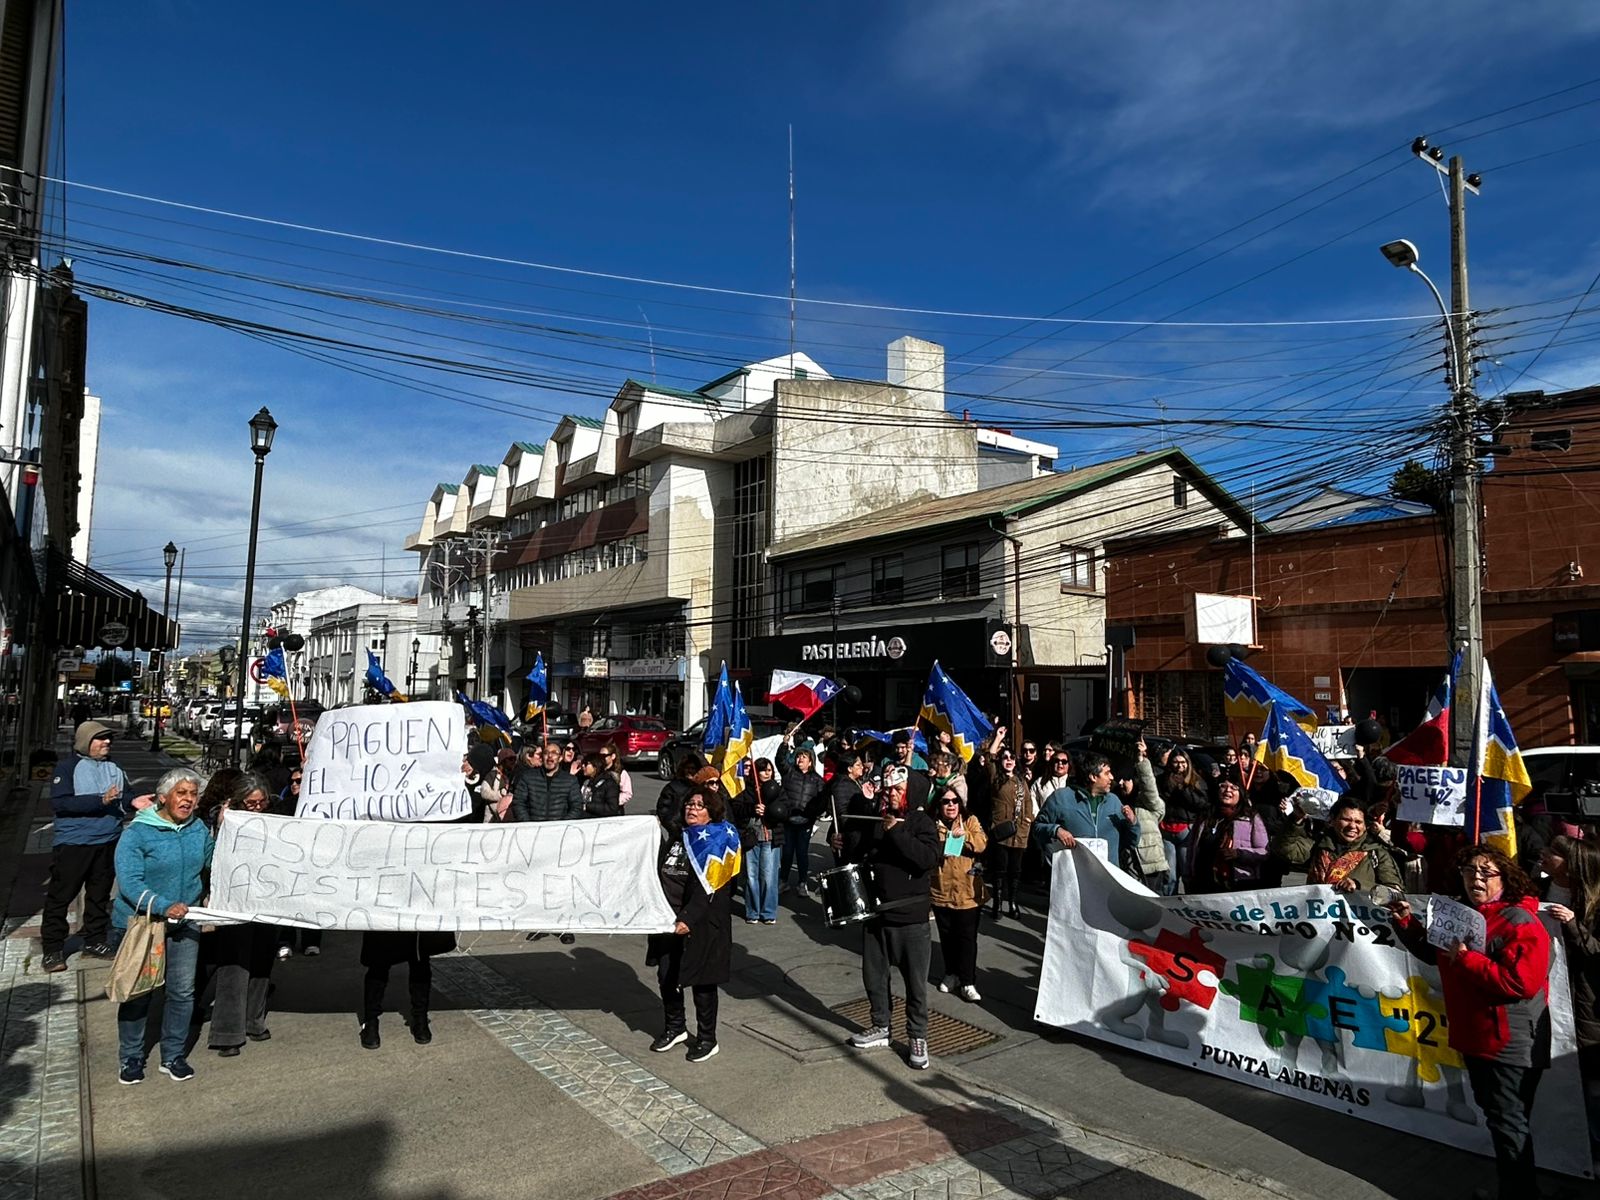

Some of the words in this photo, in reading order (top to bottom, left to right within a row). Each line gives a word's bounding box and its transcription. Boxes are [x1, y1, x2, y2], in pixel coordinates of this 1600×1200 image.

[802, 635, 888, 660] PASTELERÍA
[327, 717, 452, 760] PAGUEN
[308, 767, 336, 795] EL
[350, 759, 417, 792] 40%
[418, 782, 436, 799] DE
[1398, 767, 1465, 787] PAGEN
[1402, 787, 1419, 800] EL
[1424, 787, 1454, 807] 40%
[231, 816, 543, 871] ASOCIACION
[557, 822, 625, 868] DE
[226, 862, 528, 910] ASISTENTES
[542, 869, 603, 911] EN
[1230, 903, 1265, 922] de
[1269, 901, 1300, 920] la
[1166, 951, 1198, 983] S
[1258, 984, 1285, 1018] A
[1327, 995, 1360, 1032] E
[1200, 1043, 1272, 1078] PUNTA
[1275, 1066, 1371, 1107] ARENAS
